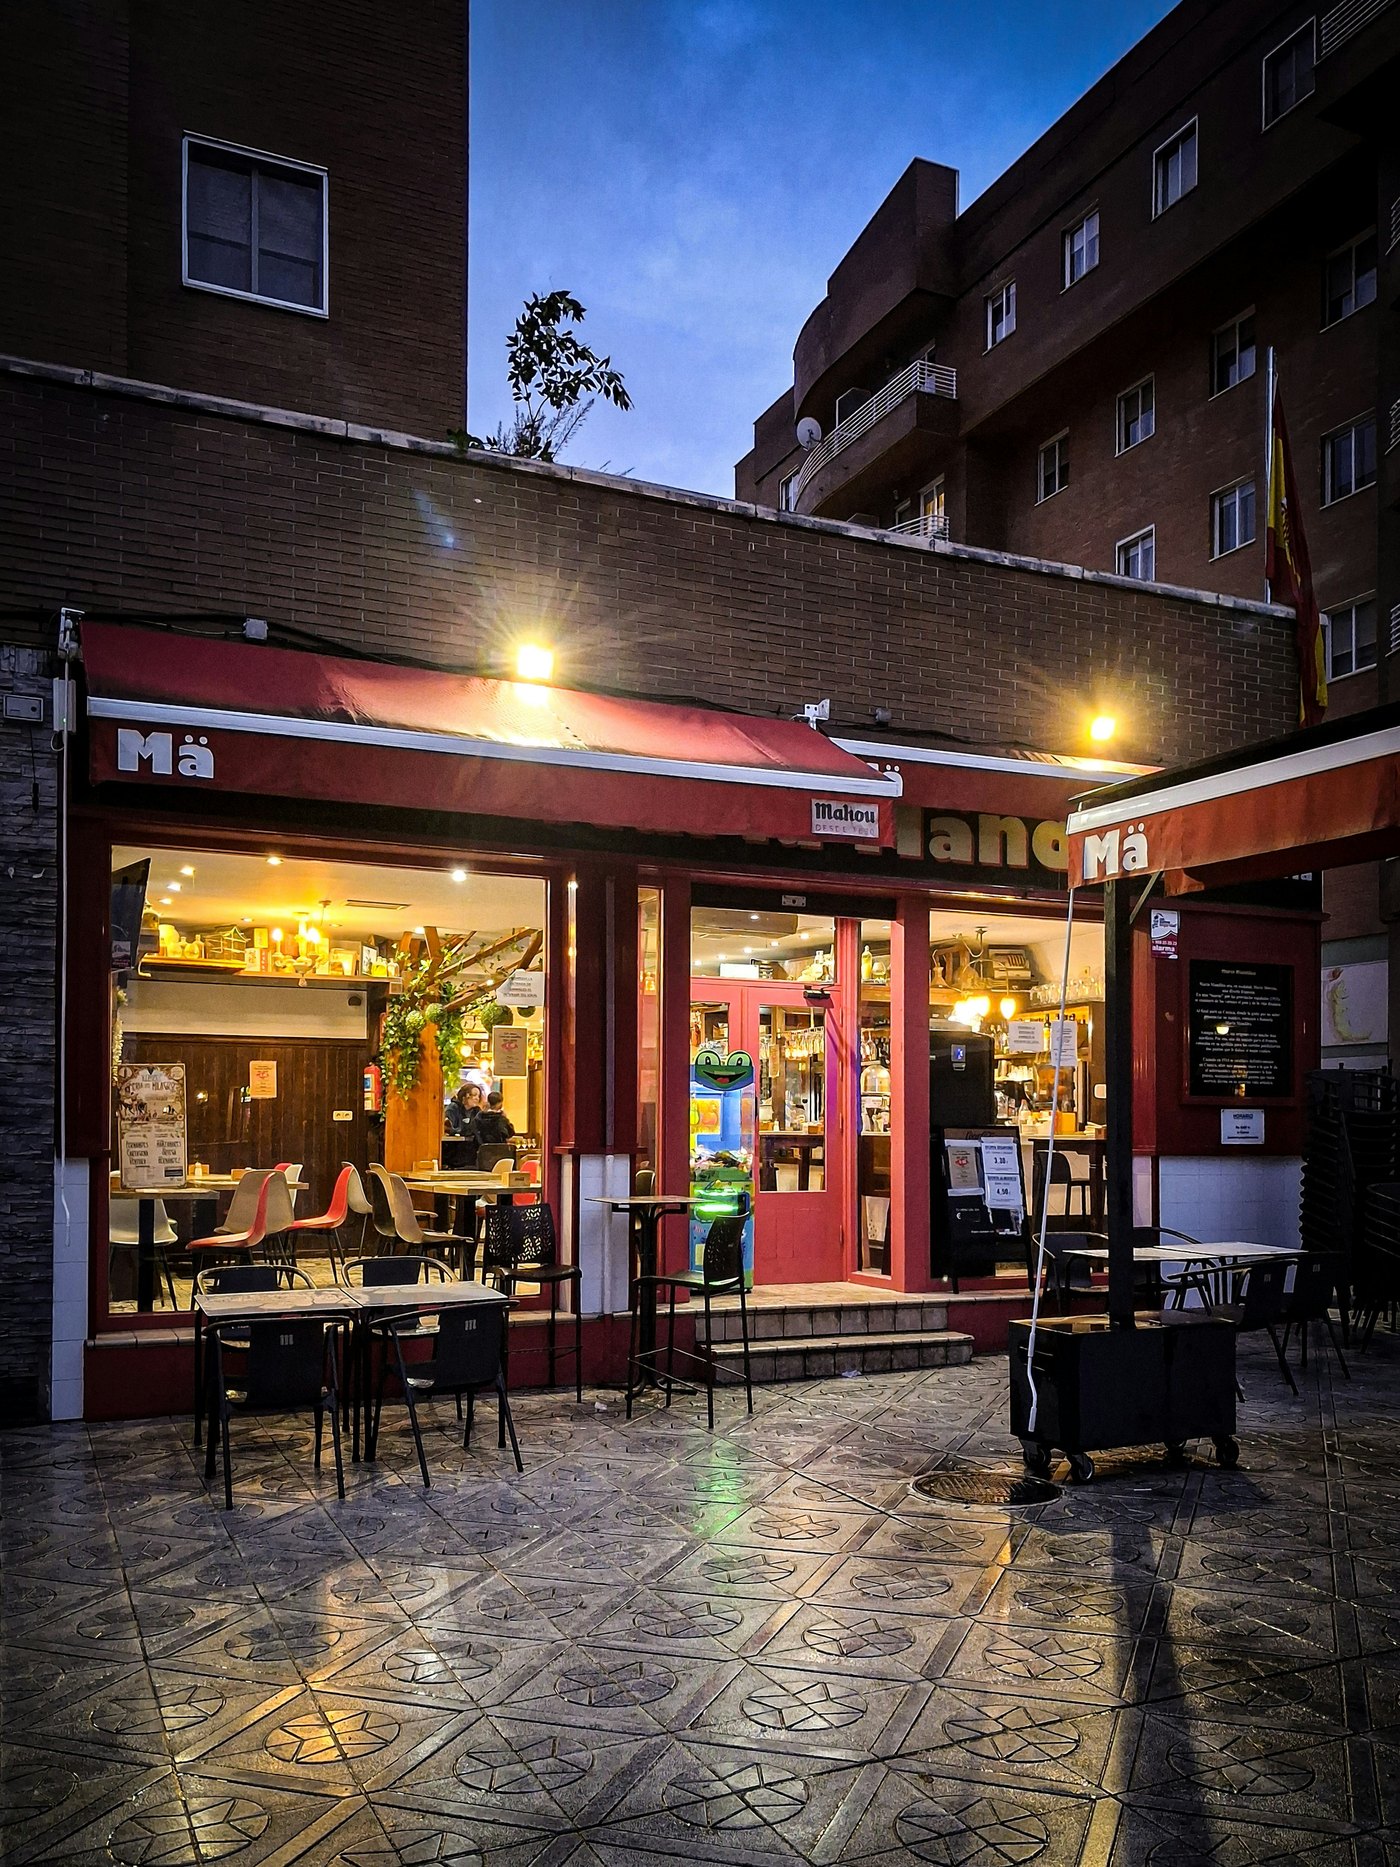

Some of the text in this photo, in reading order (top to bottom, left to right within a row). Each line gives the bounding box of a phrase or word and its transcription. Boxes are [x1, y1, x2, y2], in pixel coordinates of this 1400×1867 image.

[117, 728, 214, 778] Mä
[814, 802, 876, 823] Mahou
[815, 823, 847, 833] DESDE
[1083, 822, 1149, 880] Mä
